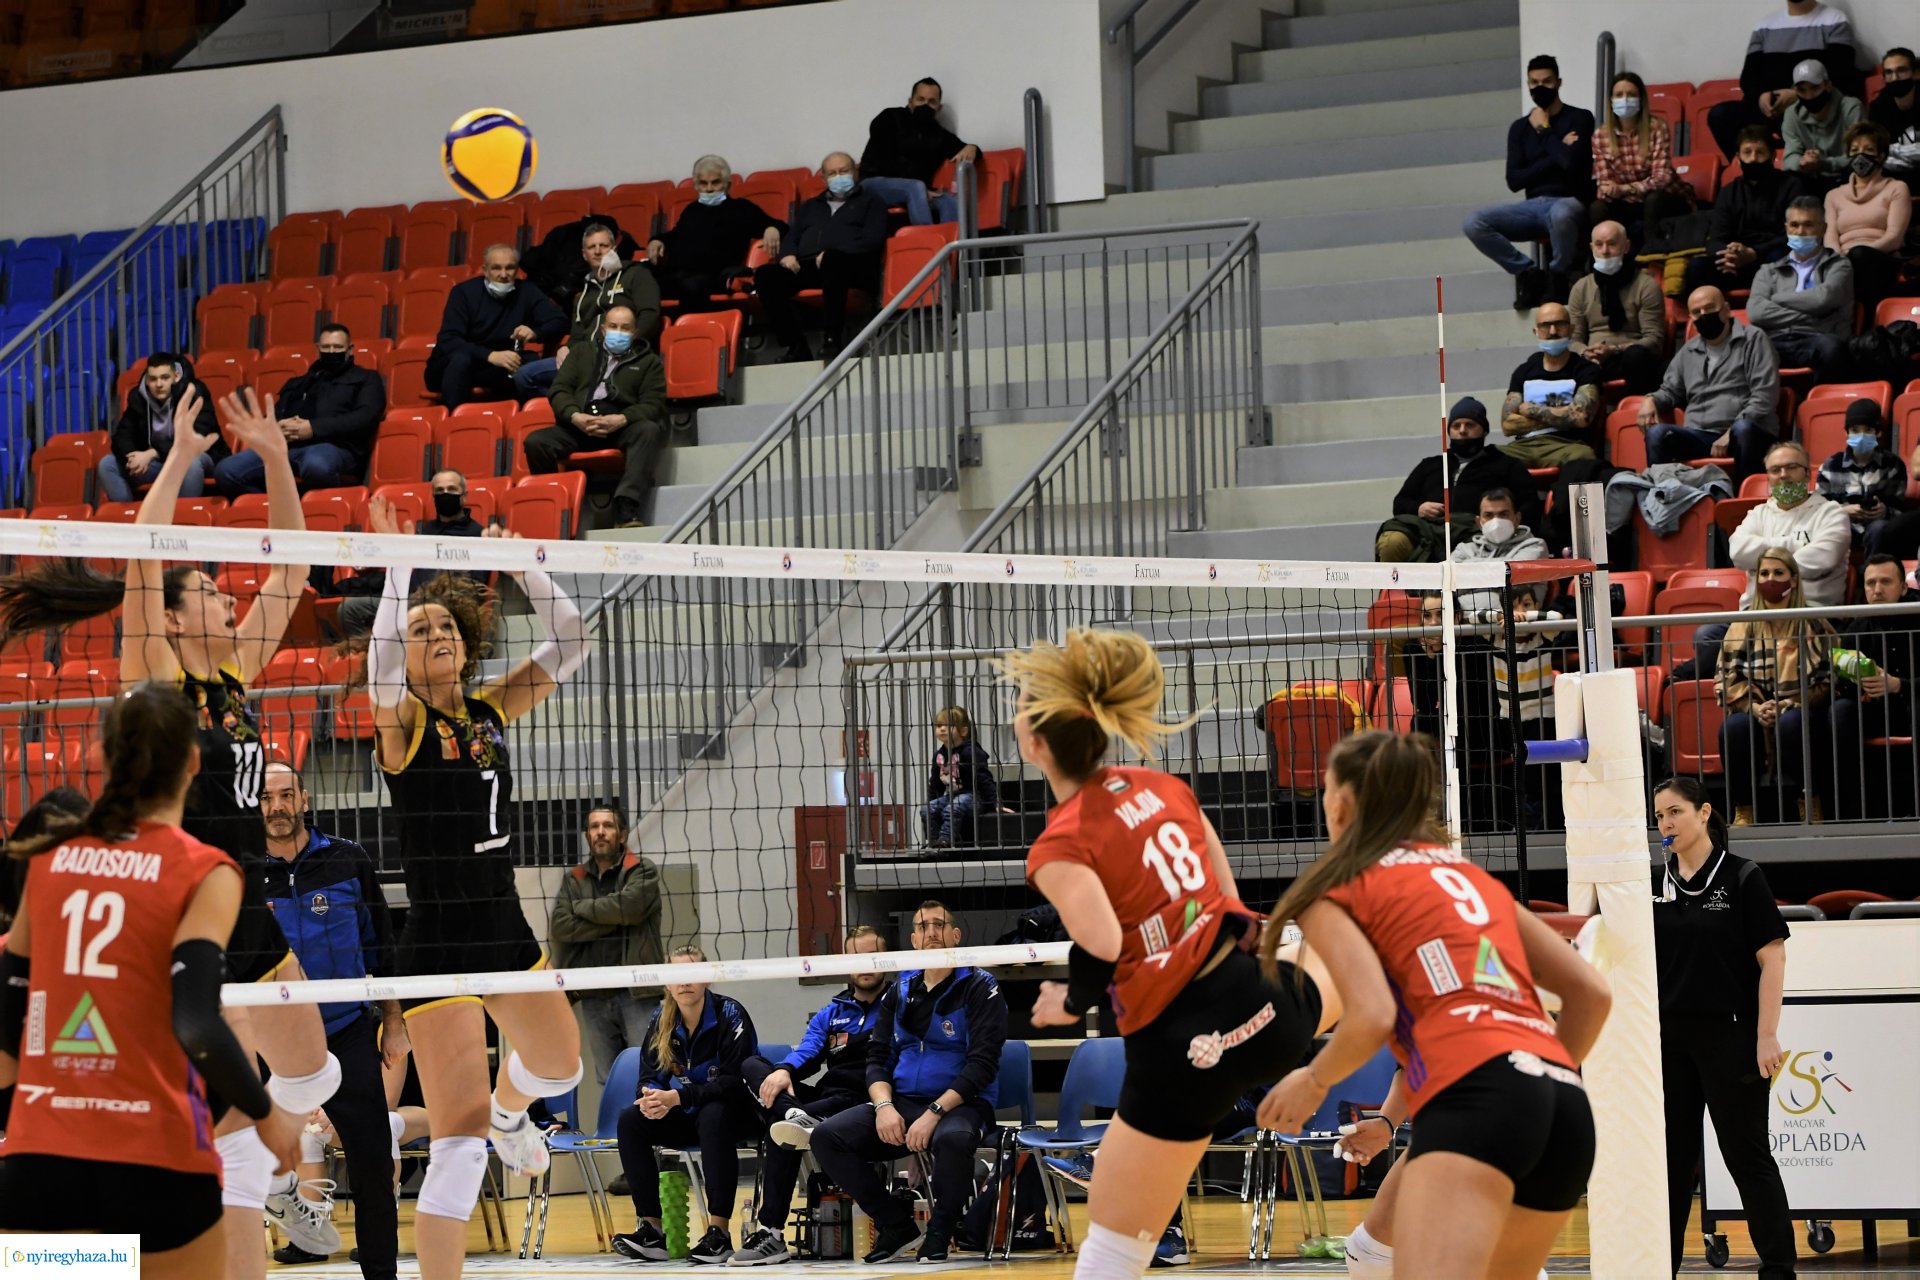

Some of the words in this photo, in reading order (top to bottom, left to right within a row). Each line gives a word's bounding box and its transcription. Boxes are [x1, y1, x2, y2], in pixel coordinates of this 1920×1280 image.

[1114, 788, 1166, 831] VAJDA
[50, 845, 162, 883] RADOSOVA
[1142, 821, 1206, 902] 18
[1429, 866, 1490, 926] 9
[61, 888, 126, 979] 12
[1768, 1129, 1866, 1152] ÖPLABDA
[1783, 1119, 1826, 1129] MAGYAR
[1779, 1156, 1834, 1167] SZÖVETSÉG
